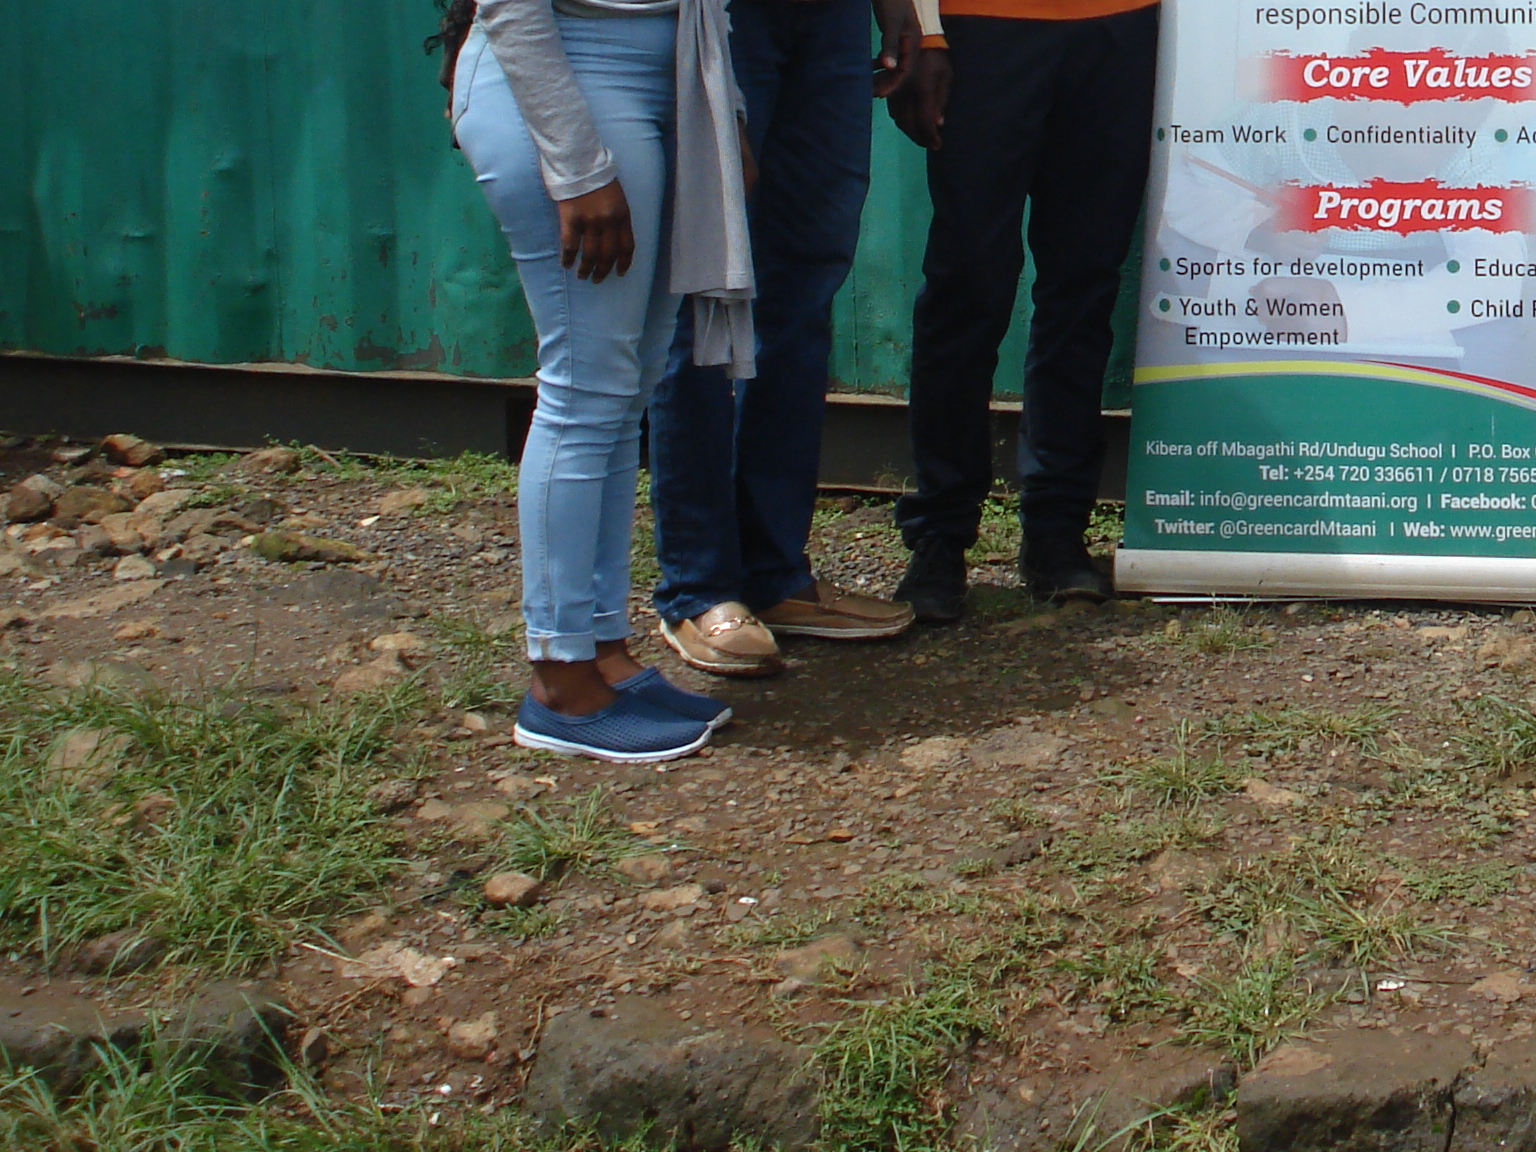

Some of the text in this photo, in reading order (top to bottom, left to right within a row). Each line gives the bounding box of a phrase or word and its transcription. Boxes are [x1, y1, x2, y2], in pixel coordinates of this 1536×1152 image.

[1257, 2, 1401, 30] responsible
[1304, 59, 1532, 88] Core Values
[1171, 125, 1286, 143] Team Work
[1327, 126, 1476, 148] Confidentiality
[1314, 191, 1503, 227] Programs
[1177, 258, 1423, 280] Sports for development
[1179, 298, 1343, 316] Youth & Women
[1472, 300, 1523, 317] Child
[1186, 327, 1338, 350] Empowerment
[1146, 441, 1192, 456] Kibera
[1197, 441, 1218, 456] off
[1222, 442, 1294, 460] Mbagathi
[1299, 442, 1385, 461] Rd/Undugu
[1390, 443, 1442, 458] School
[1469, 444, 1496, 458] P.O.
[1502, 444, 1530, 459] Box
[1259, 465, 1289, 480] Tel:
[1294, 465, 1335, 481] +254
[1339, 466, 1369, 481] 720
[1374, 466, 1432, 482] 336611
[1440, 467, 1447, 483] /
[1453, 467, 1494, 482] 0718
[1146, 490, 1194, 506] Email:
[1200, 491, 1417, 512] info@greencardmtaani.org
[1441, 493, 1526, 509] Facebook:
[1155, 519, 1214, 534] Twitter:
[1220, 520, 1376, 538] @GreencardMtaani
[1403, 521, 1445, 537] Web:
